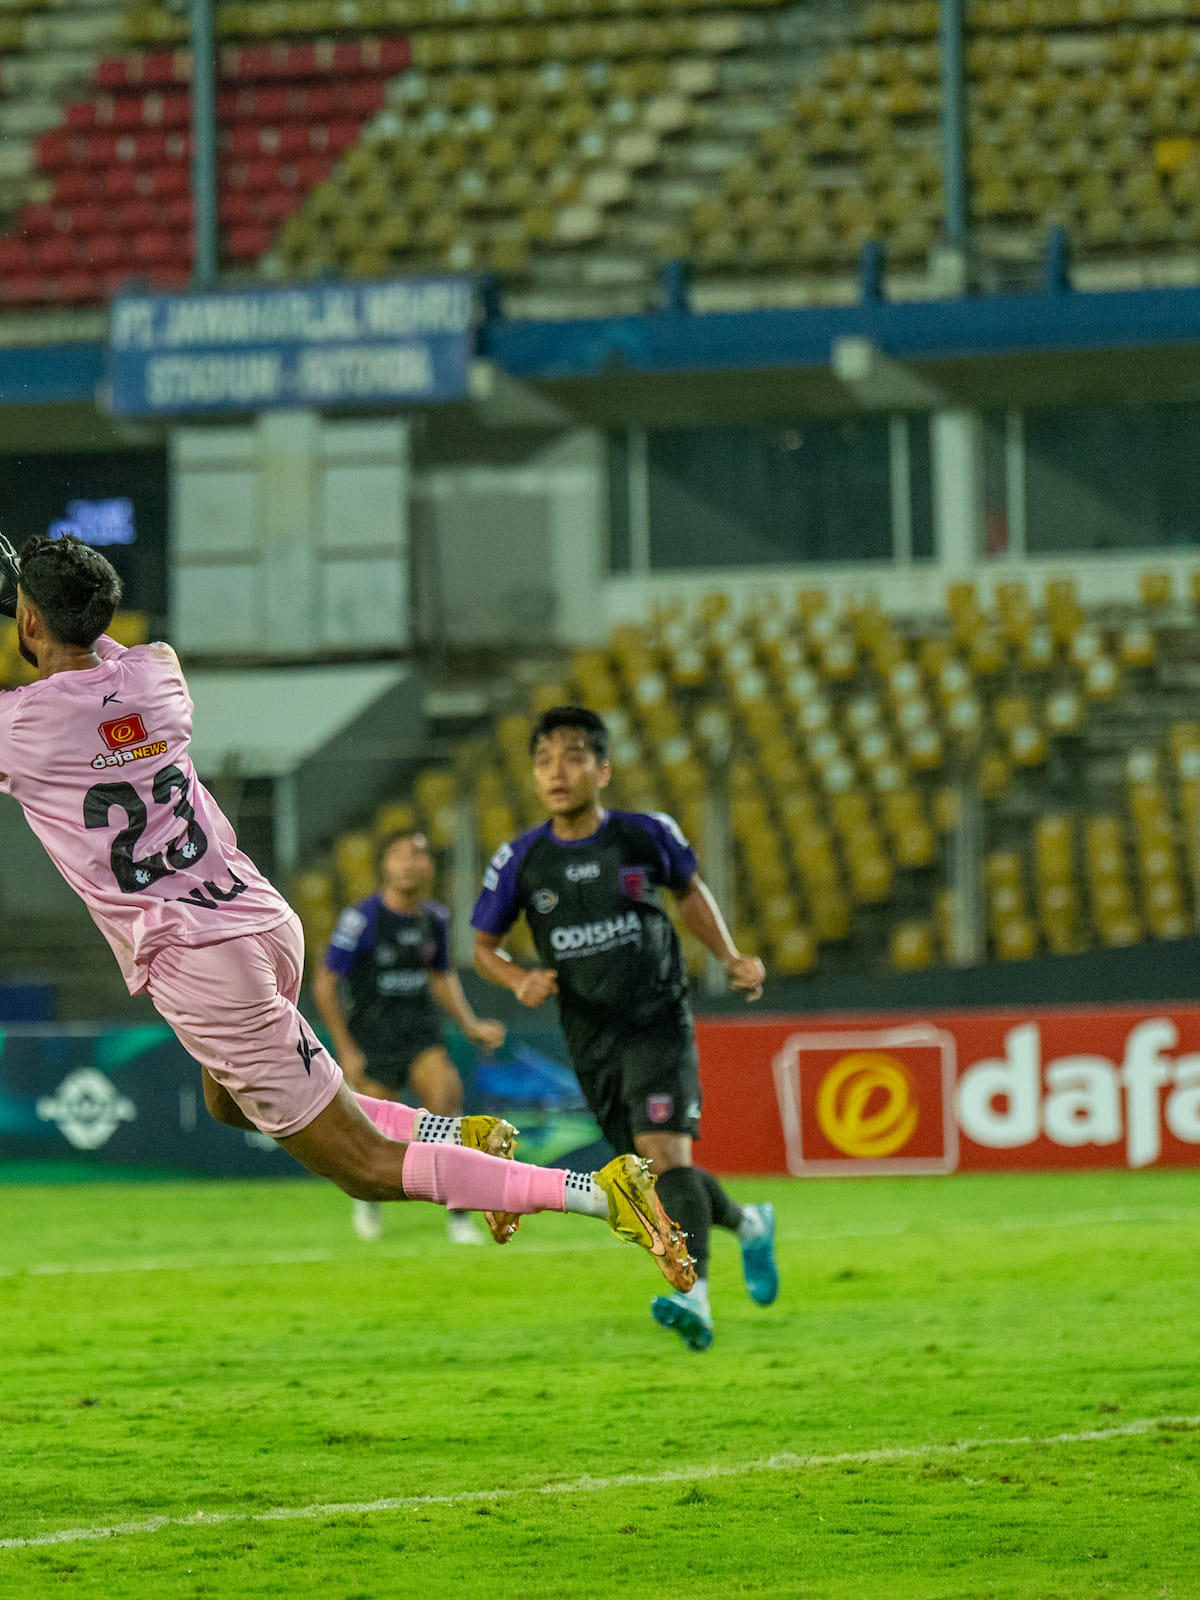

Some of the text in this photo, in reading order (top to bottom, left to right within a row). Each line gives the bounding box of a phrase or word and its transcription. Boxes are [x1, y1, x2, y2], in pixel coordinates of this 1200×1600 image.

[91, 741, 168, 770] dafaNEWS
[83, 764, 208, 894] 23
[550, 910, 642, 951] ODISHA
